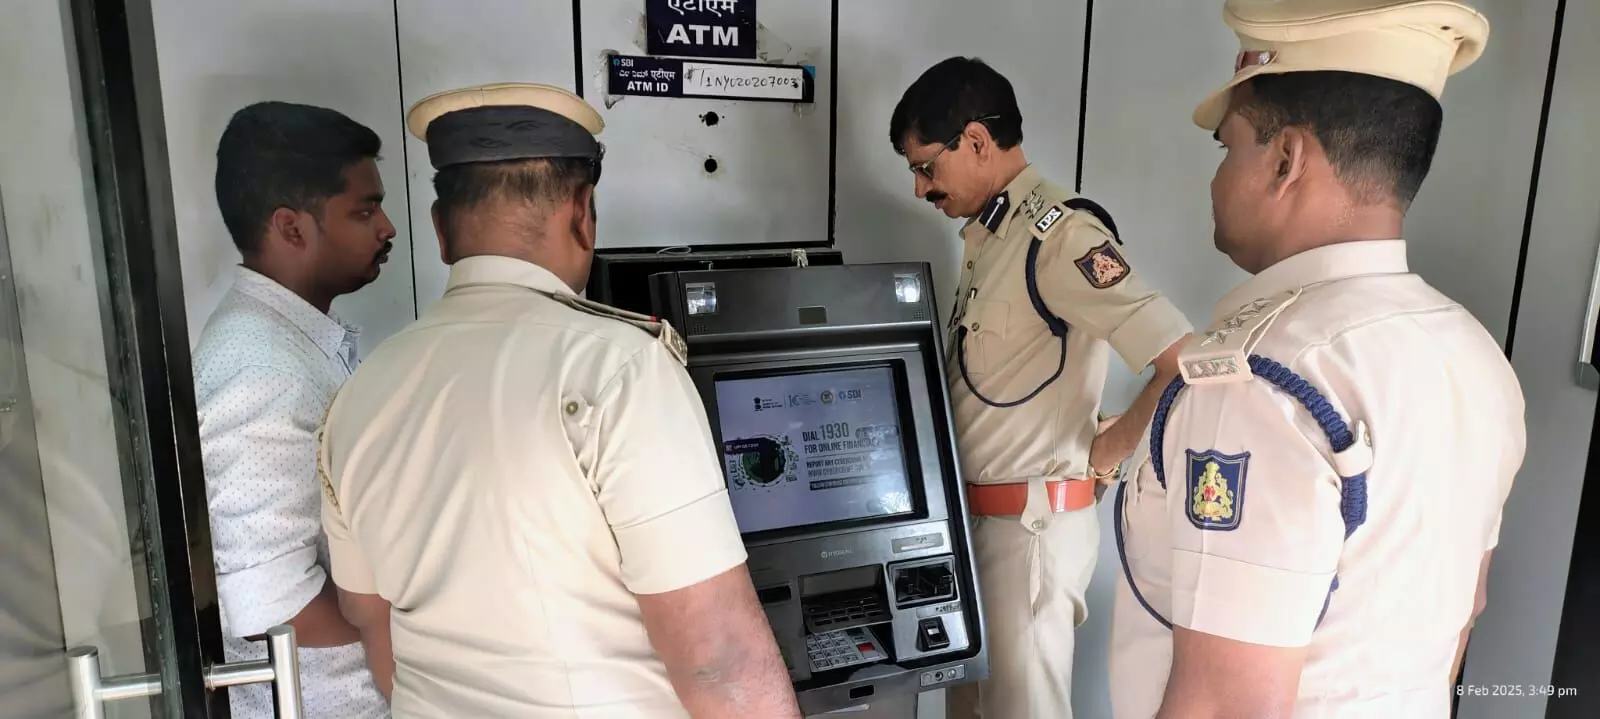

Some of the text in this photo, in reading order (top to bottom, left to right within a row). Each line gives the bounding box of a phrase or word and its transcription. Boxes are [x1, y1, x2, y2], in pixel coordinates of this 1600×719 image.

[666, 24, 739, 46] ATM
[620, 59, 634, 67] SBI
[650, 68, 676, 81] एटीएम
[627, 81, 669, 92] ATM ID
[802, 431, 820, 442] DIAL
[820, 422, 849, 440] 1930
[804, 438, 873, 454] FOR ONLINE FINANC
